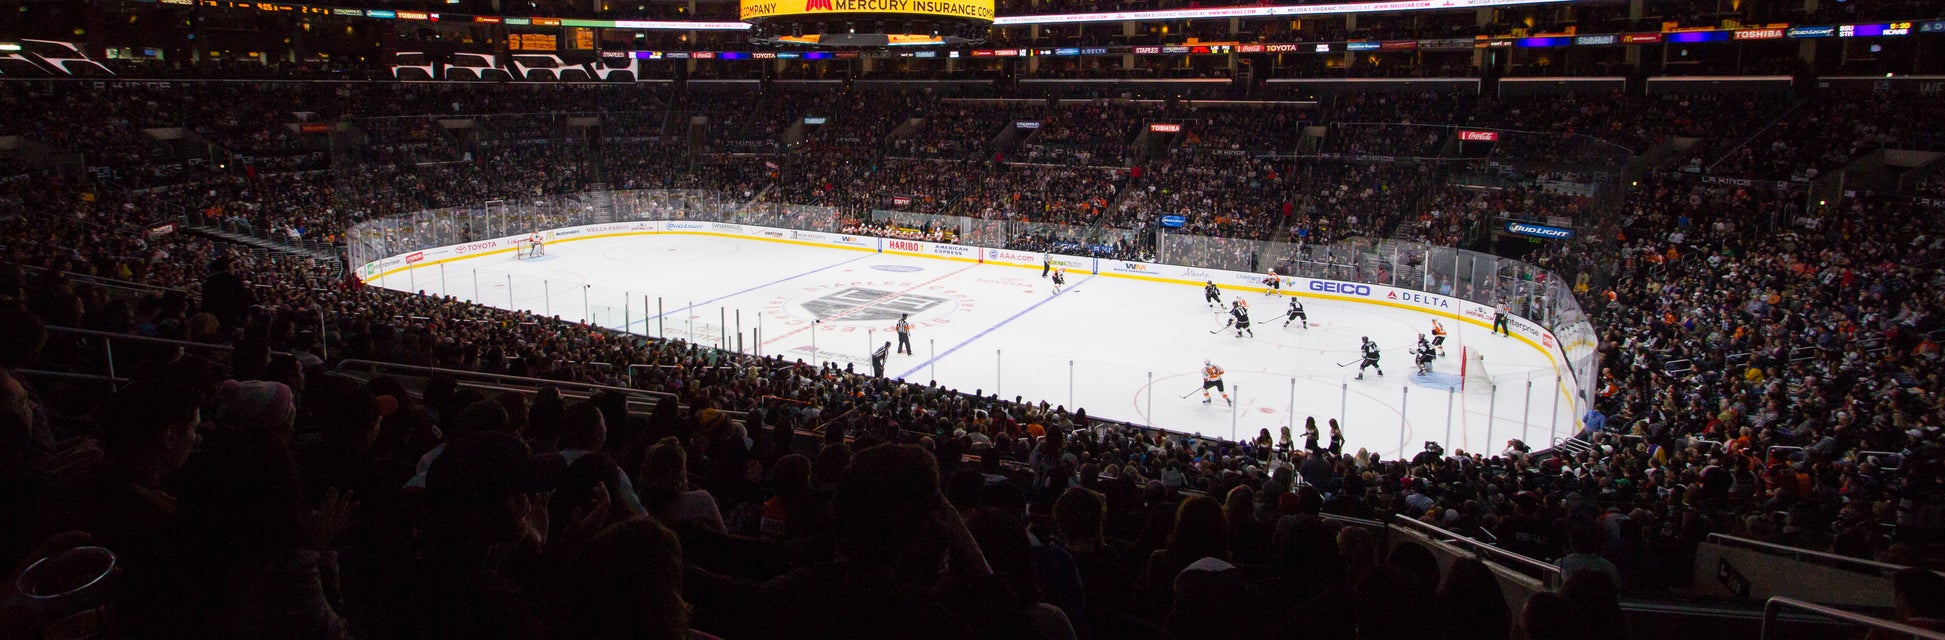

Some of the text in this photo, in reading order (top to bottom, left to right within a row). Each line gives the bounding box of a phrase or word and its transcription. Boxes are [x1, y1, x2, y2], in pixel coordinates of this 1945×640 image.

[836, 0, 908, 11] MERCURY
[913, 1, 976, 15] INSURANCE
[1735, 29, 1782, 38] TOSHIBA
[1266, 44, 1297, 52] TOYOTA
[1701, 175, 1751, 187] LA KINGS
[1509, 222, 1568, 237] BUD LIGHT
[467, 241, 497, 251] TOYOTA
[889, 240, 919, 252] HARIBO
[935, 244, 968, 252] AMERICAN
[999, 252, 1034, 262] AAA.com
[1309, 280, 1370, 296] GEICO
[1402, 292, 1448, 308] DELTA
[1507, 318, 1539, 337] nterprise
